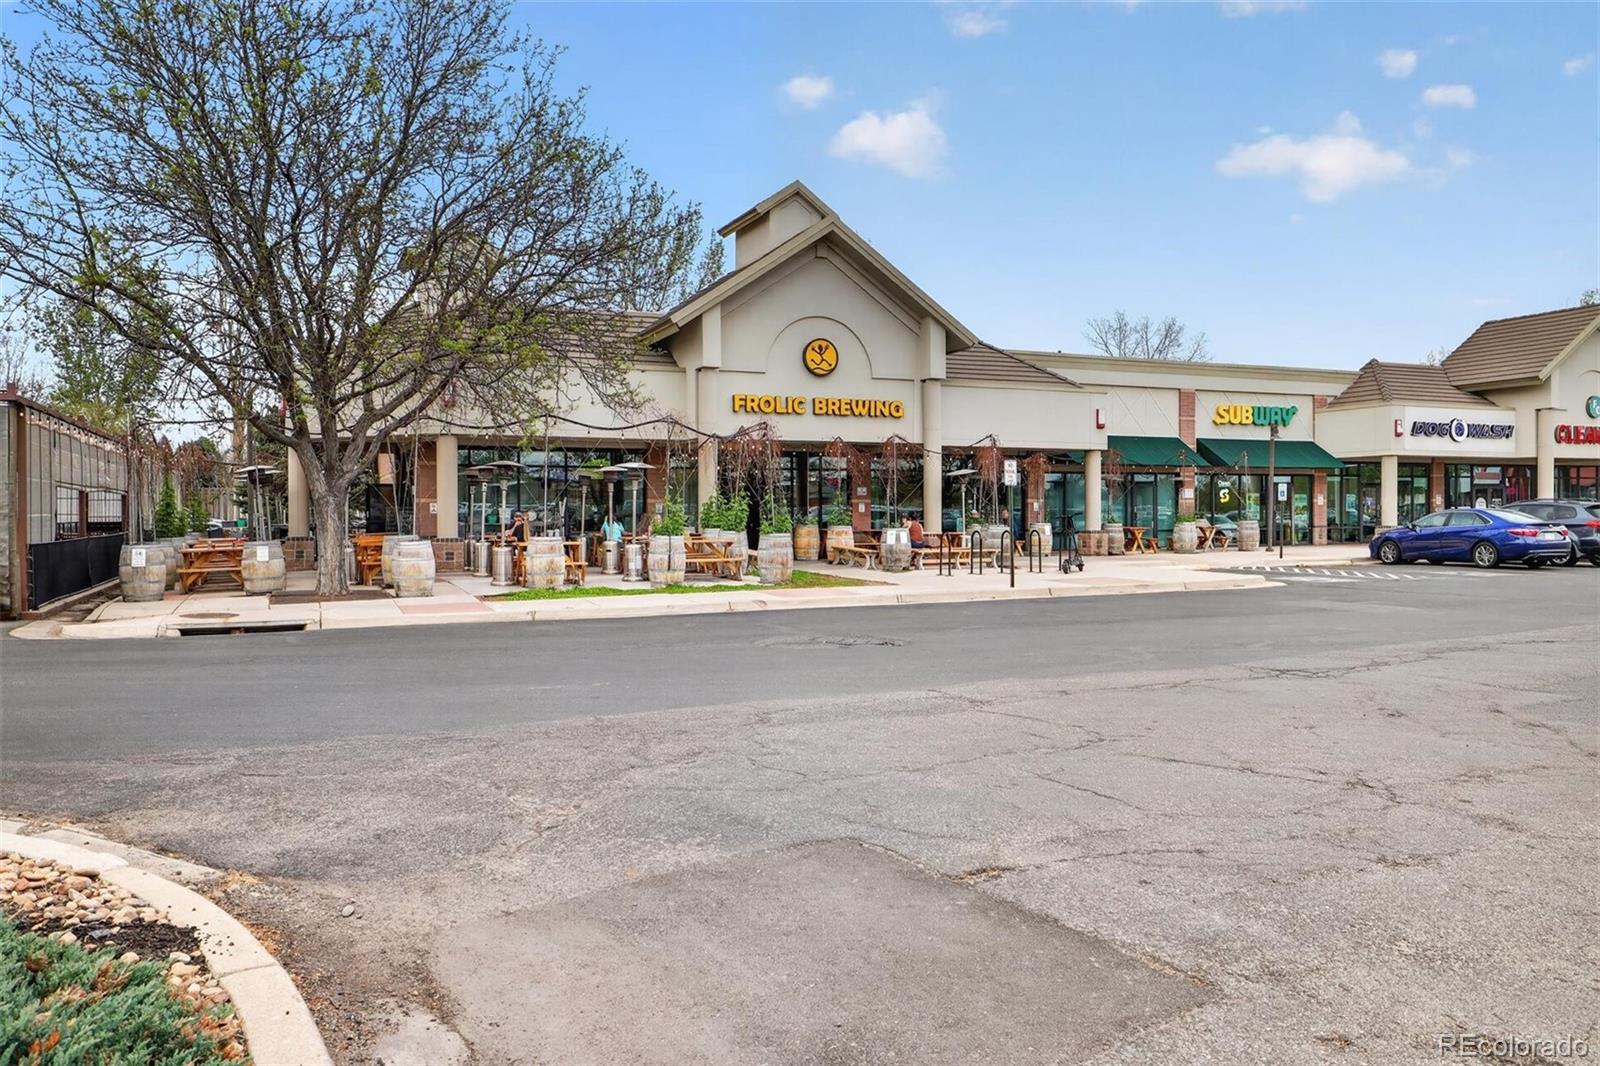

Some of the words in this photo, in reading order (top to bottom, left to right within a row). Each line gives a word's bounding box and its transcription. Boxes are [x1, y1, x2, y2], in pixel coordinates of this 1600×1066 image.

[732, 394, 807, 415] FROLIC
[812, 397, 905, 418] BREWING
[1212, 404, 1298, 427] SUBWAY
[1410, 421, 1452, 438] DOG
[1466, 423, 1515, 439] WASH
